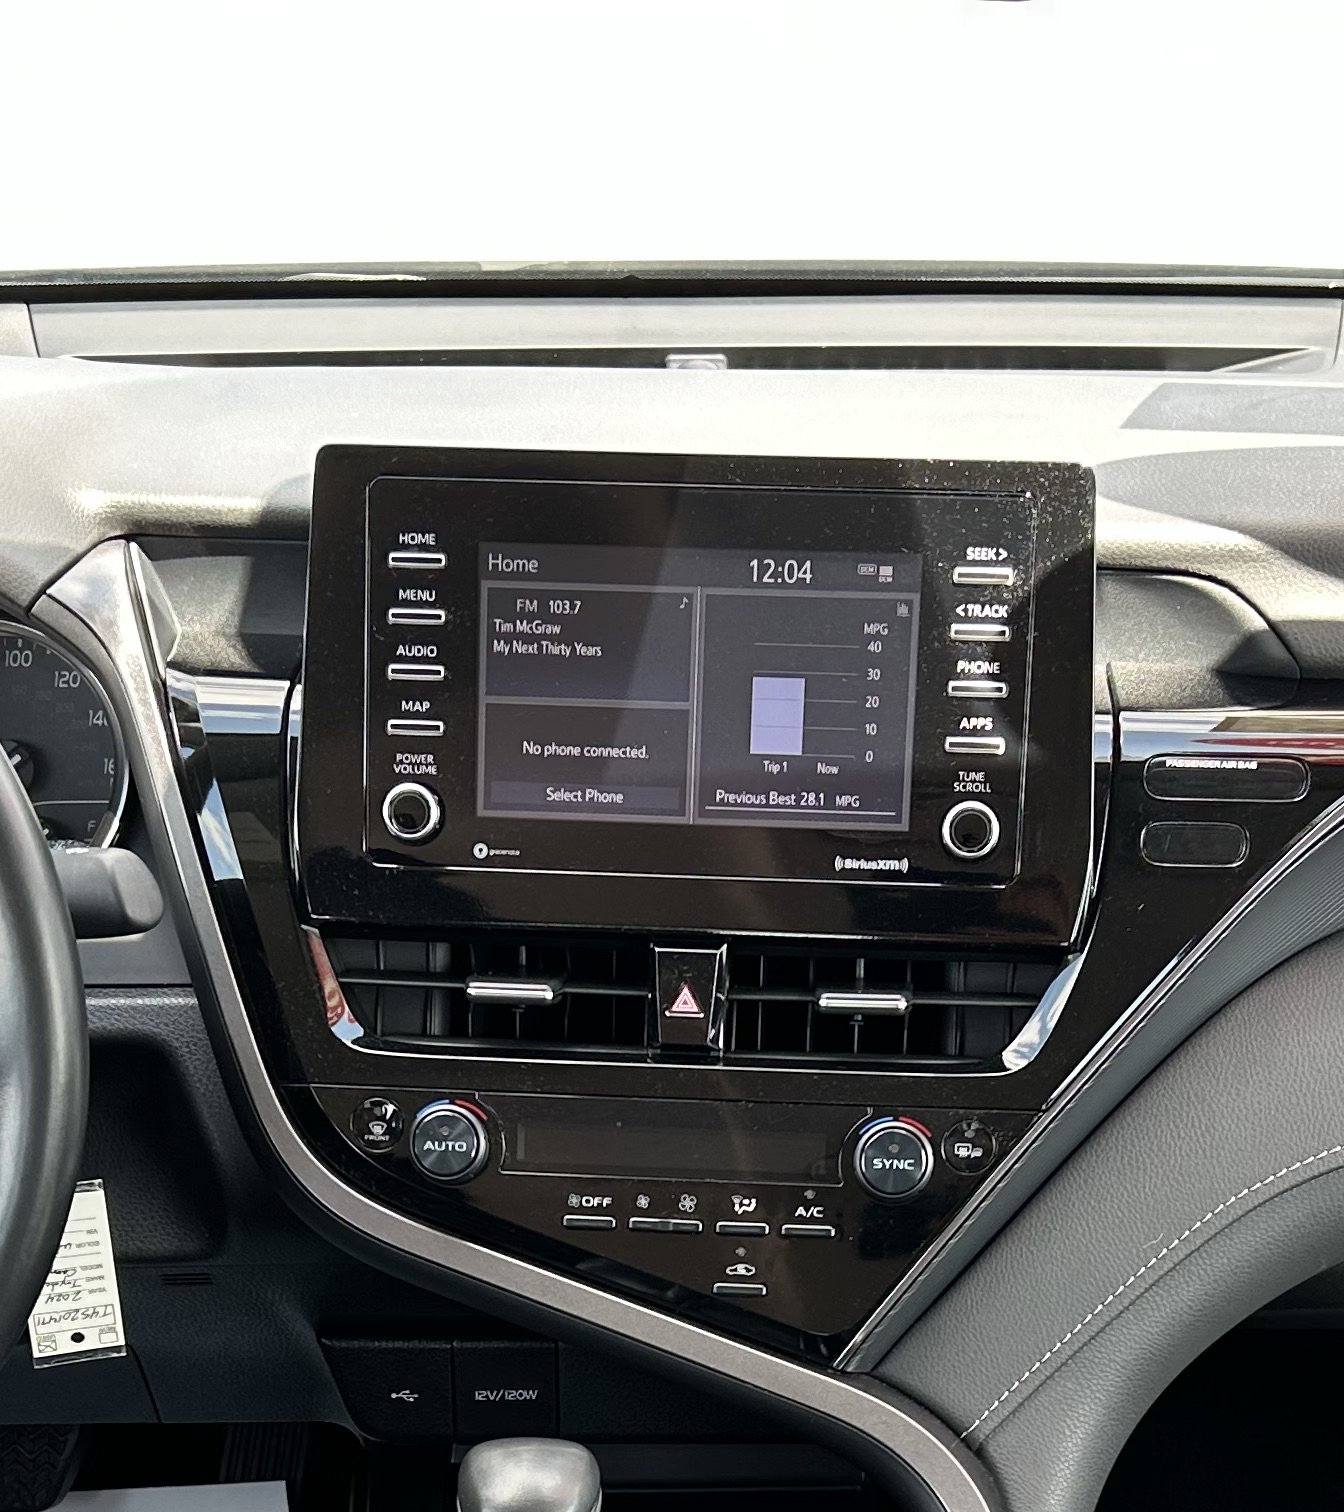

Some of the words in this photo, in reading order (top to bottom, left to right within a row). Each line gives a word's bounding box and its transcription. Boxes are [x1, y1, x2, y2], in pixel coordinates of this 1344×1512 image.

[399, 532, 436, 545] HOME
[488, 553, 539, 573] Home
[748, 559, 814, 584] 12:04
[399, 589, 436, 602] MENU
[516, 599, 538, 614] FM
[548, 600, 582, 616] 103.7
[494, 619, 514, 634] Tim
[516, 620, 562, 636] McGraw
[864, 623, 889, 637] MPG
[396, 645, 438, 658] AUDIO
[493, 640, 511, 657] My
[512, 641, 539, 656] Next
[540, 642, 573, 659] Thirty
[574, 642, 603, 658] Years
[867, 641, 883, 654] 40
[5, 649, 33, 668] 100
[957, 660, 1001, 675] PHONE
[54, 671, 81, 689] 120
[866, 669, 881, 682] 30
[401, 701, 431, 713] MAP
[865, 696, 880, 709] 20
[864, 723, 878, 736] 10
[959, 717, 993, 731] APPS
[522, 741, 542, 757] No
[544, 743, 582, 761] phone
[584, 744, 650, 759] connected.
[865, 750, 874, 763] 0
[396, 753, 434, 764] POWER
[1165, 759, 1220, 769] PASSENGER
[1221, 760, 1237, 769] AIR
[1237, 760, 1258, 770] BAG
[393, 764, 438, 776] VOLUME
[763, 760, 781, 775] Trip
[783, 761, 788, 773] 1
[816, 763, 840, 776] Now
[958, 770, 986, 782] TUNE
[953, 781, 992, 793] SCROLL
[546, 786, 583, 802] Select
[585, 788, 624, 804] Phone
[715, 790, 767, 806] Previous
[769, 791, 796, 806] Best
[800, 792, 825, 807] 28.1
[835, 794, 860, 808] MPG
[87, 820, 96, 832] F
[423, 1138, 467, 1152] AUTO
[872, 1158, 915, 1170] SYNC
[582, 1195, 612, 1208] OFF
[795, 1206, 824, 1219] A/C
[75, 1240, 100, 1248] COLOR
[79, 1263, 104, 1271] MODEL
[45, 1289, 82, 1304] 2024
[88, 1287, 107, 1295] YEAR
[474, 1388, 539, 1402] 12V/120W
